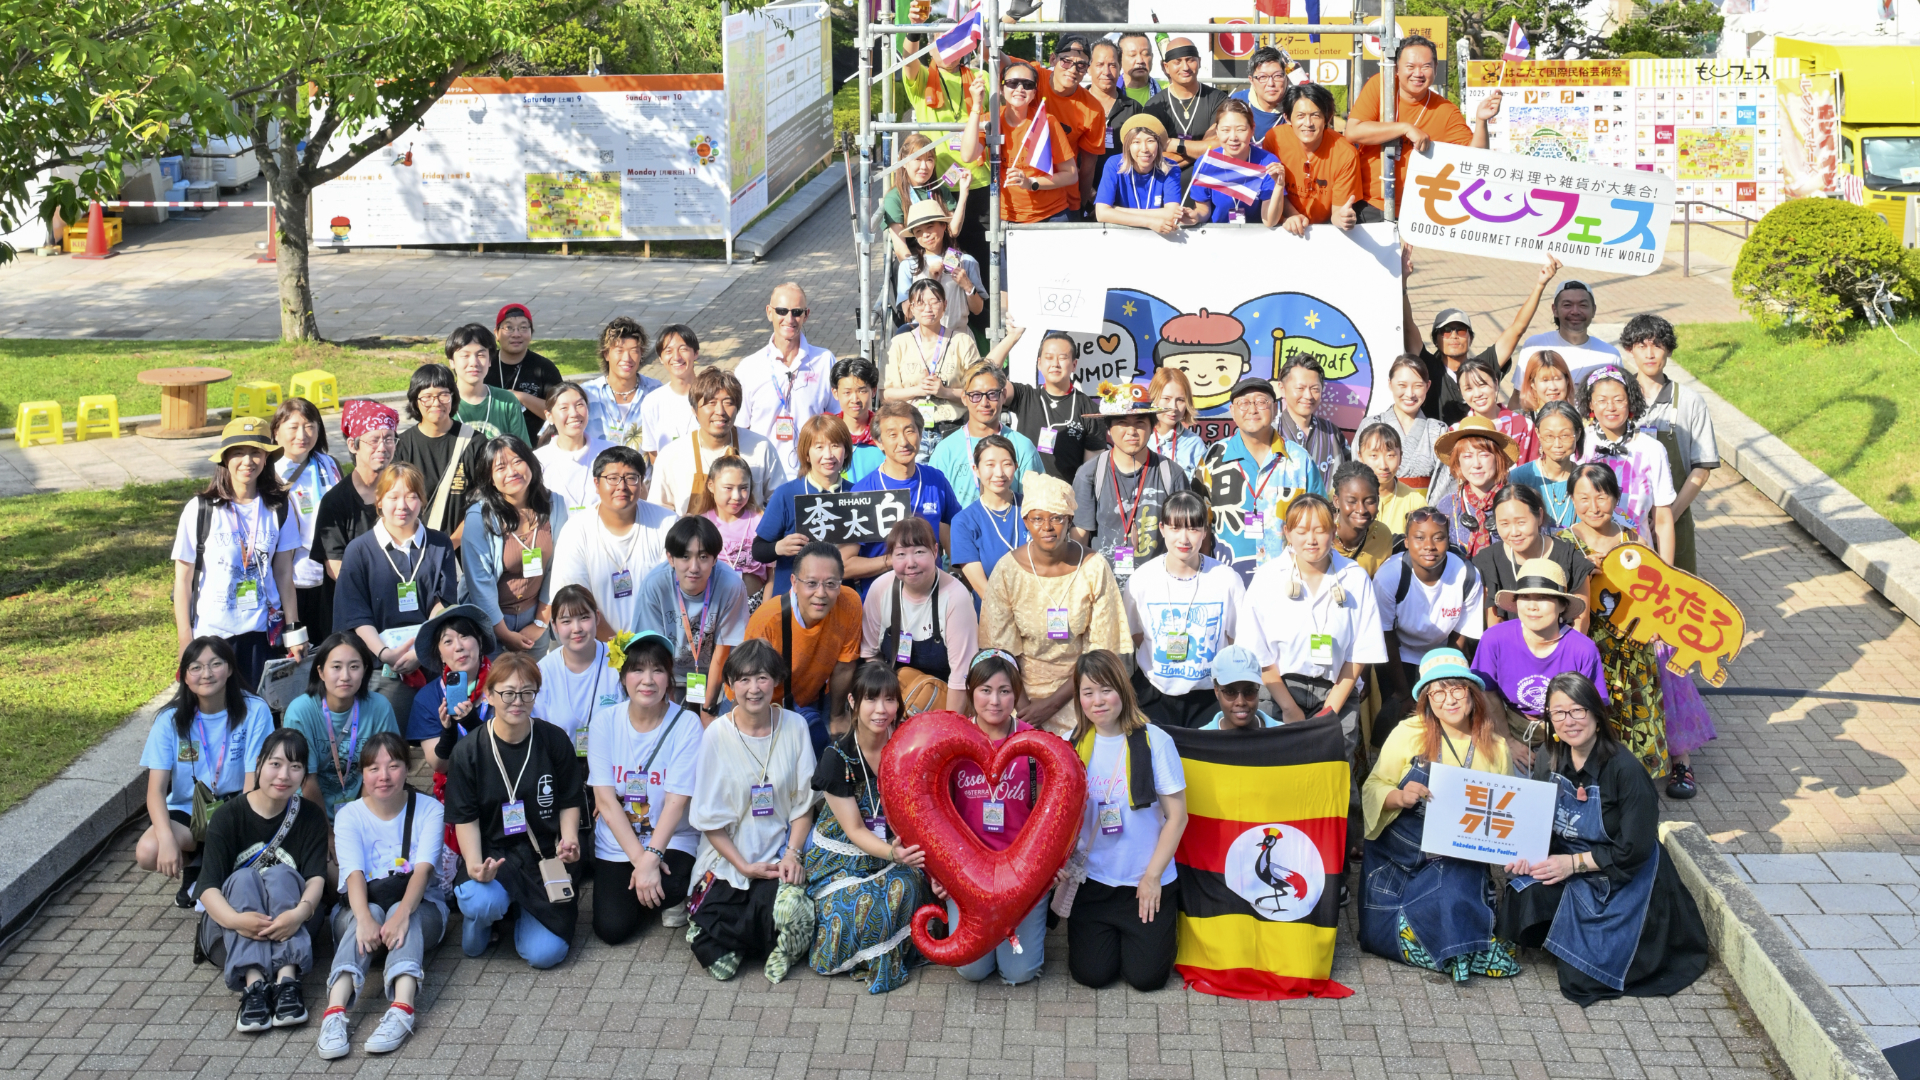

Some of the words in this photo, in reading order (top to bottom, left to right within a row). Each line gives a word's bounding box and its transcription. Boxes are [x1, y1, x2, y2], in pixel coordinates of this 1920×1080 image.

[1505, 67, 1622, 78] はこだて国際民俗芸術祭
[523, 95, 556, 104] Saturday
[625, 94, 652, 102] Sunday
[673, 93, 682, 101] 10
[422, 172, 445, 180] Friday
[466, 171, 471, 179] 8
[627, 168, 657, 177] Monday
[1459, 161, 1659, 199] 世界の料理や雑貨が大集合!
[72, 240, 86, 248] KIR
[1411, 221, 1446, 237] GOODS
[1450, 227, 1456, 238] &
[1460, 230, 1510, 246] GOURMET
[1515, 237, 1544, 250] FROM
[1548, 241, 1590, 256] AROUND
[1595, 246, 1614, 259] THE
[1619, 250, 1655, 264] WORLD
[1044, 293, 1072, 312] 88
[1285, 346, 1348, 372] #mdf
[802, 492, 906, 542] 李太白
[1160, 664, 1185, 676] Hand
[995, 780, 1026, 801] Oils
[1463, 778, 1522, 792] HAKODATE
[1452, 841, 1477, 851] Hakodate
[1497, 848, 1518, 857] Festival
